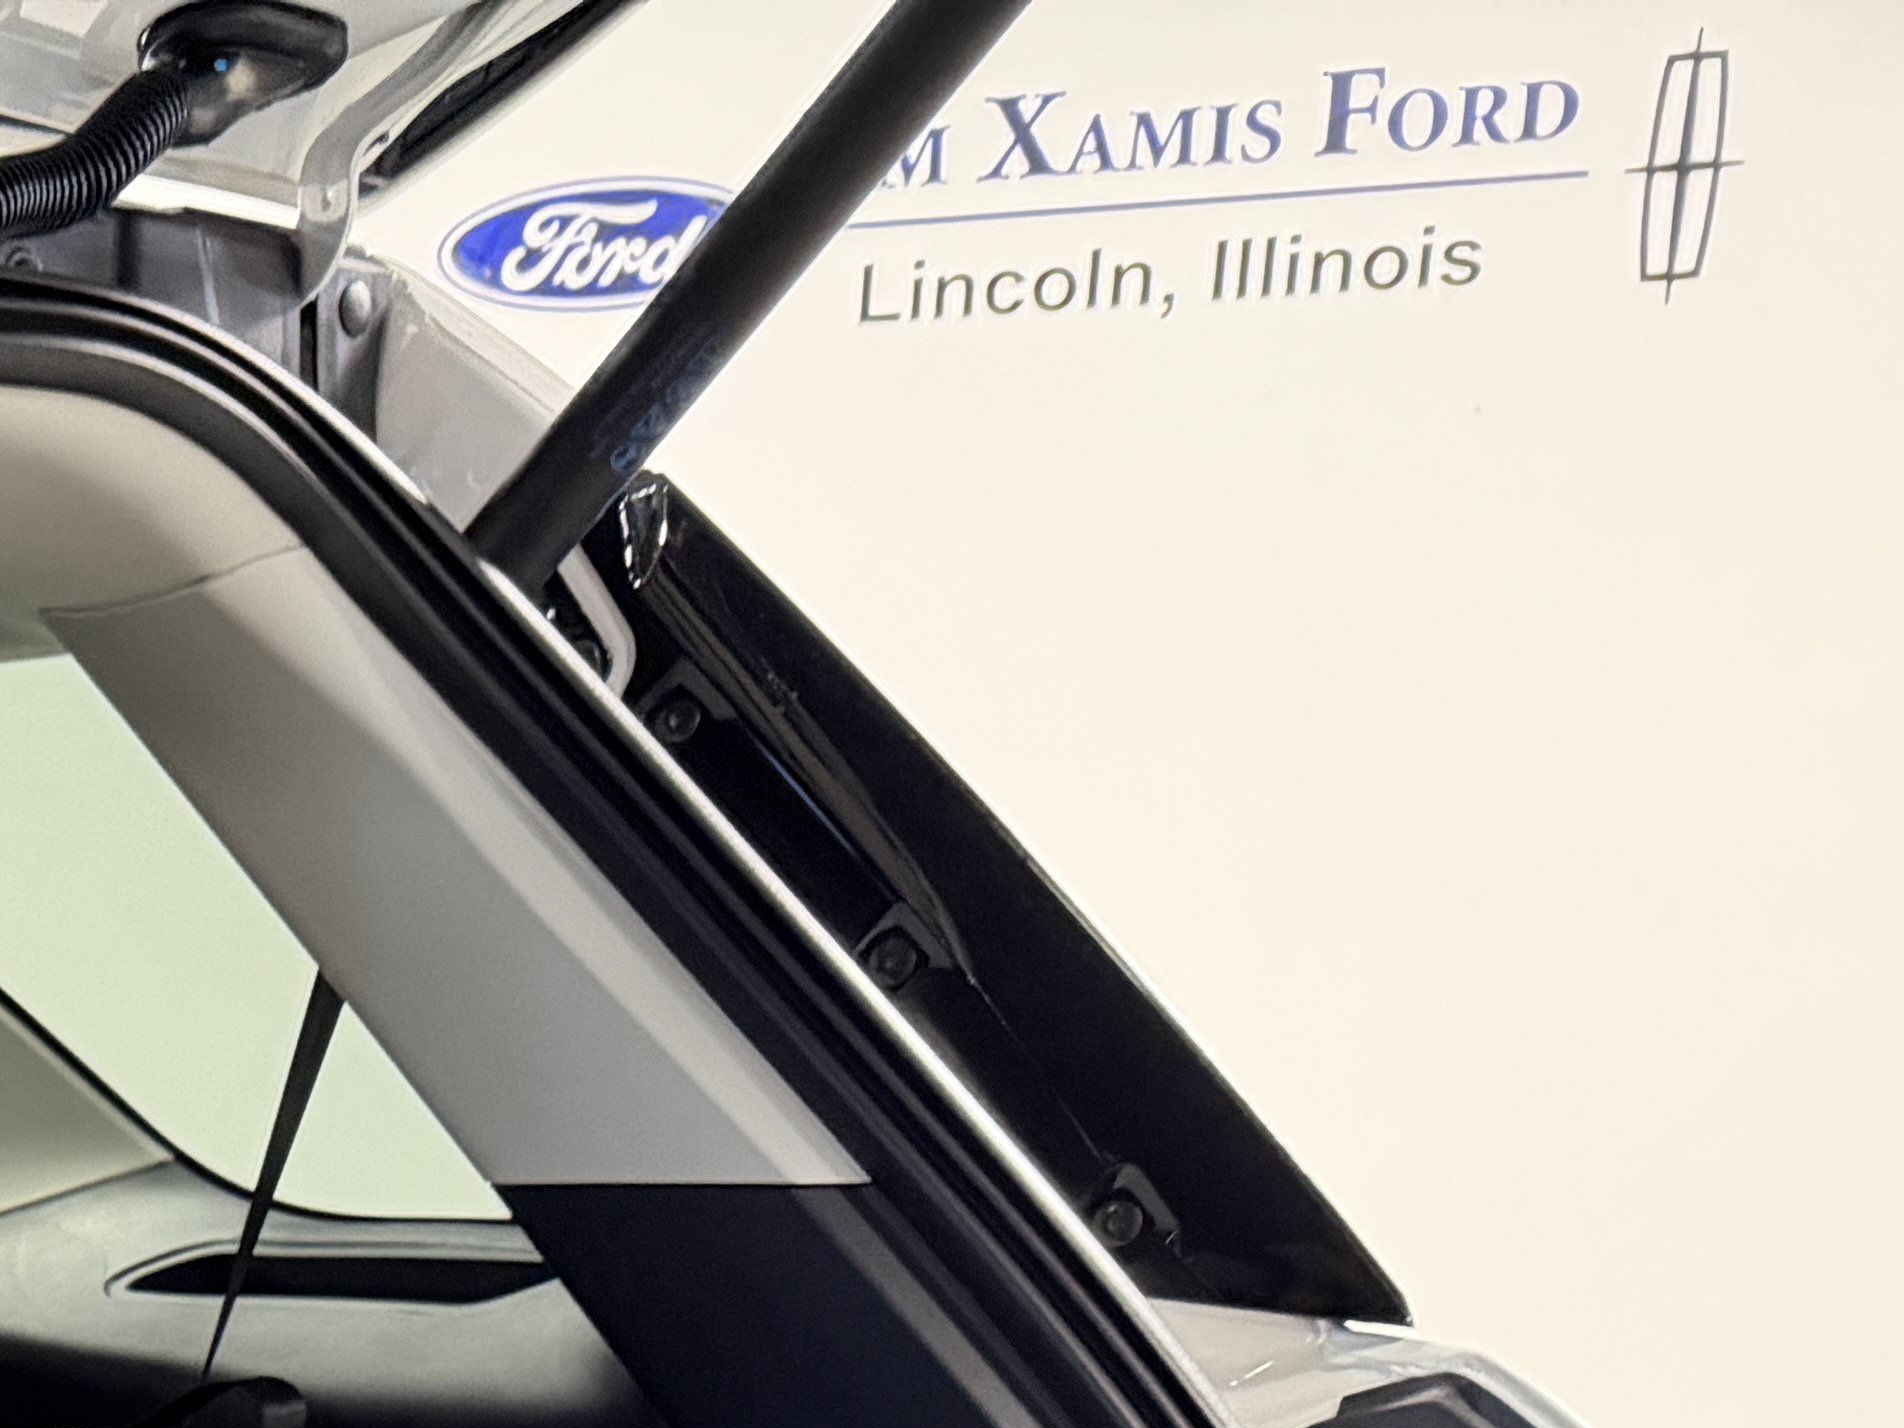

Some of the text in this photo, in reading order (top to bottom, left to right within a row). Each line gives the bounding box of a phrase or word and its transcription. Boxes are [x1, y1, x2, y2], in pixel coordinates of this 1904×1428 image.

[976, 90, 1282, 184] XAMIS
[1313, 66, 1579, 158] FORD
[500, 198, 708, 292] Ford
[858, 225, 1483, 324] Lincoln, Illinois
